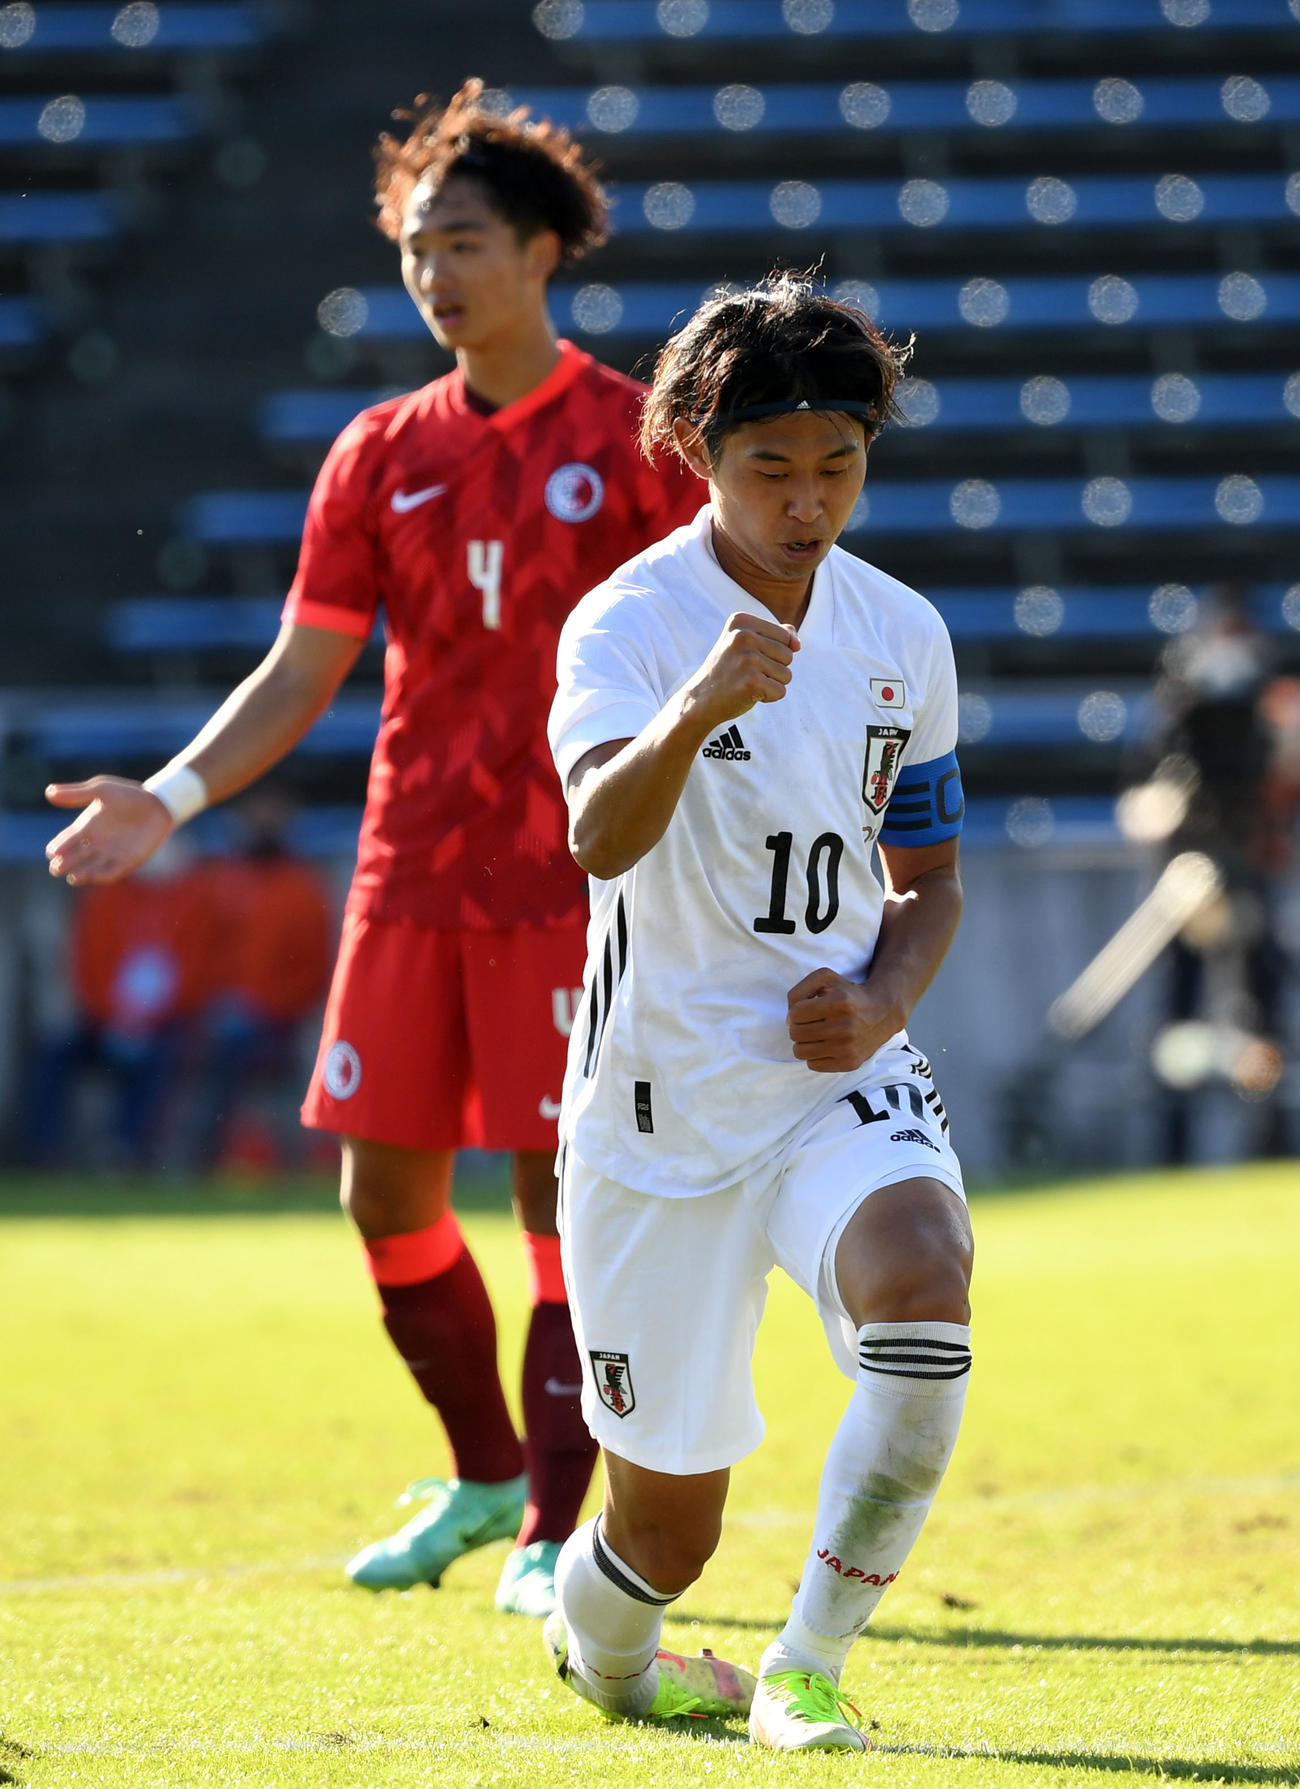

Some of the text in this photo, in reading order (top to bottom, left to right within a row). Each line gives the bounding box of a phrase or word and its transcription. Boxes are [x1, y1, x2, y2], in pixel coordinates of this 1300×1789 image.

[466, 539, 503, 631] 4
[701, 746, 752, 762] adidas
[753, 830, 844, 935] 10
[599, 1352, 621, 1361] JAPAN
